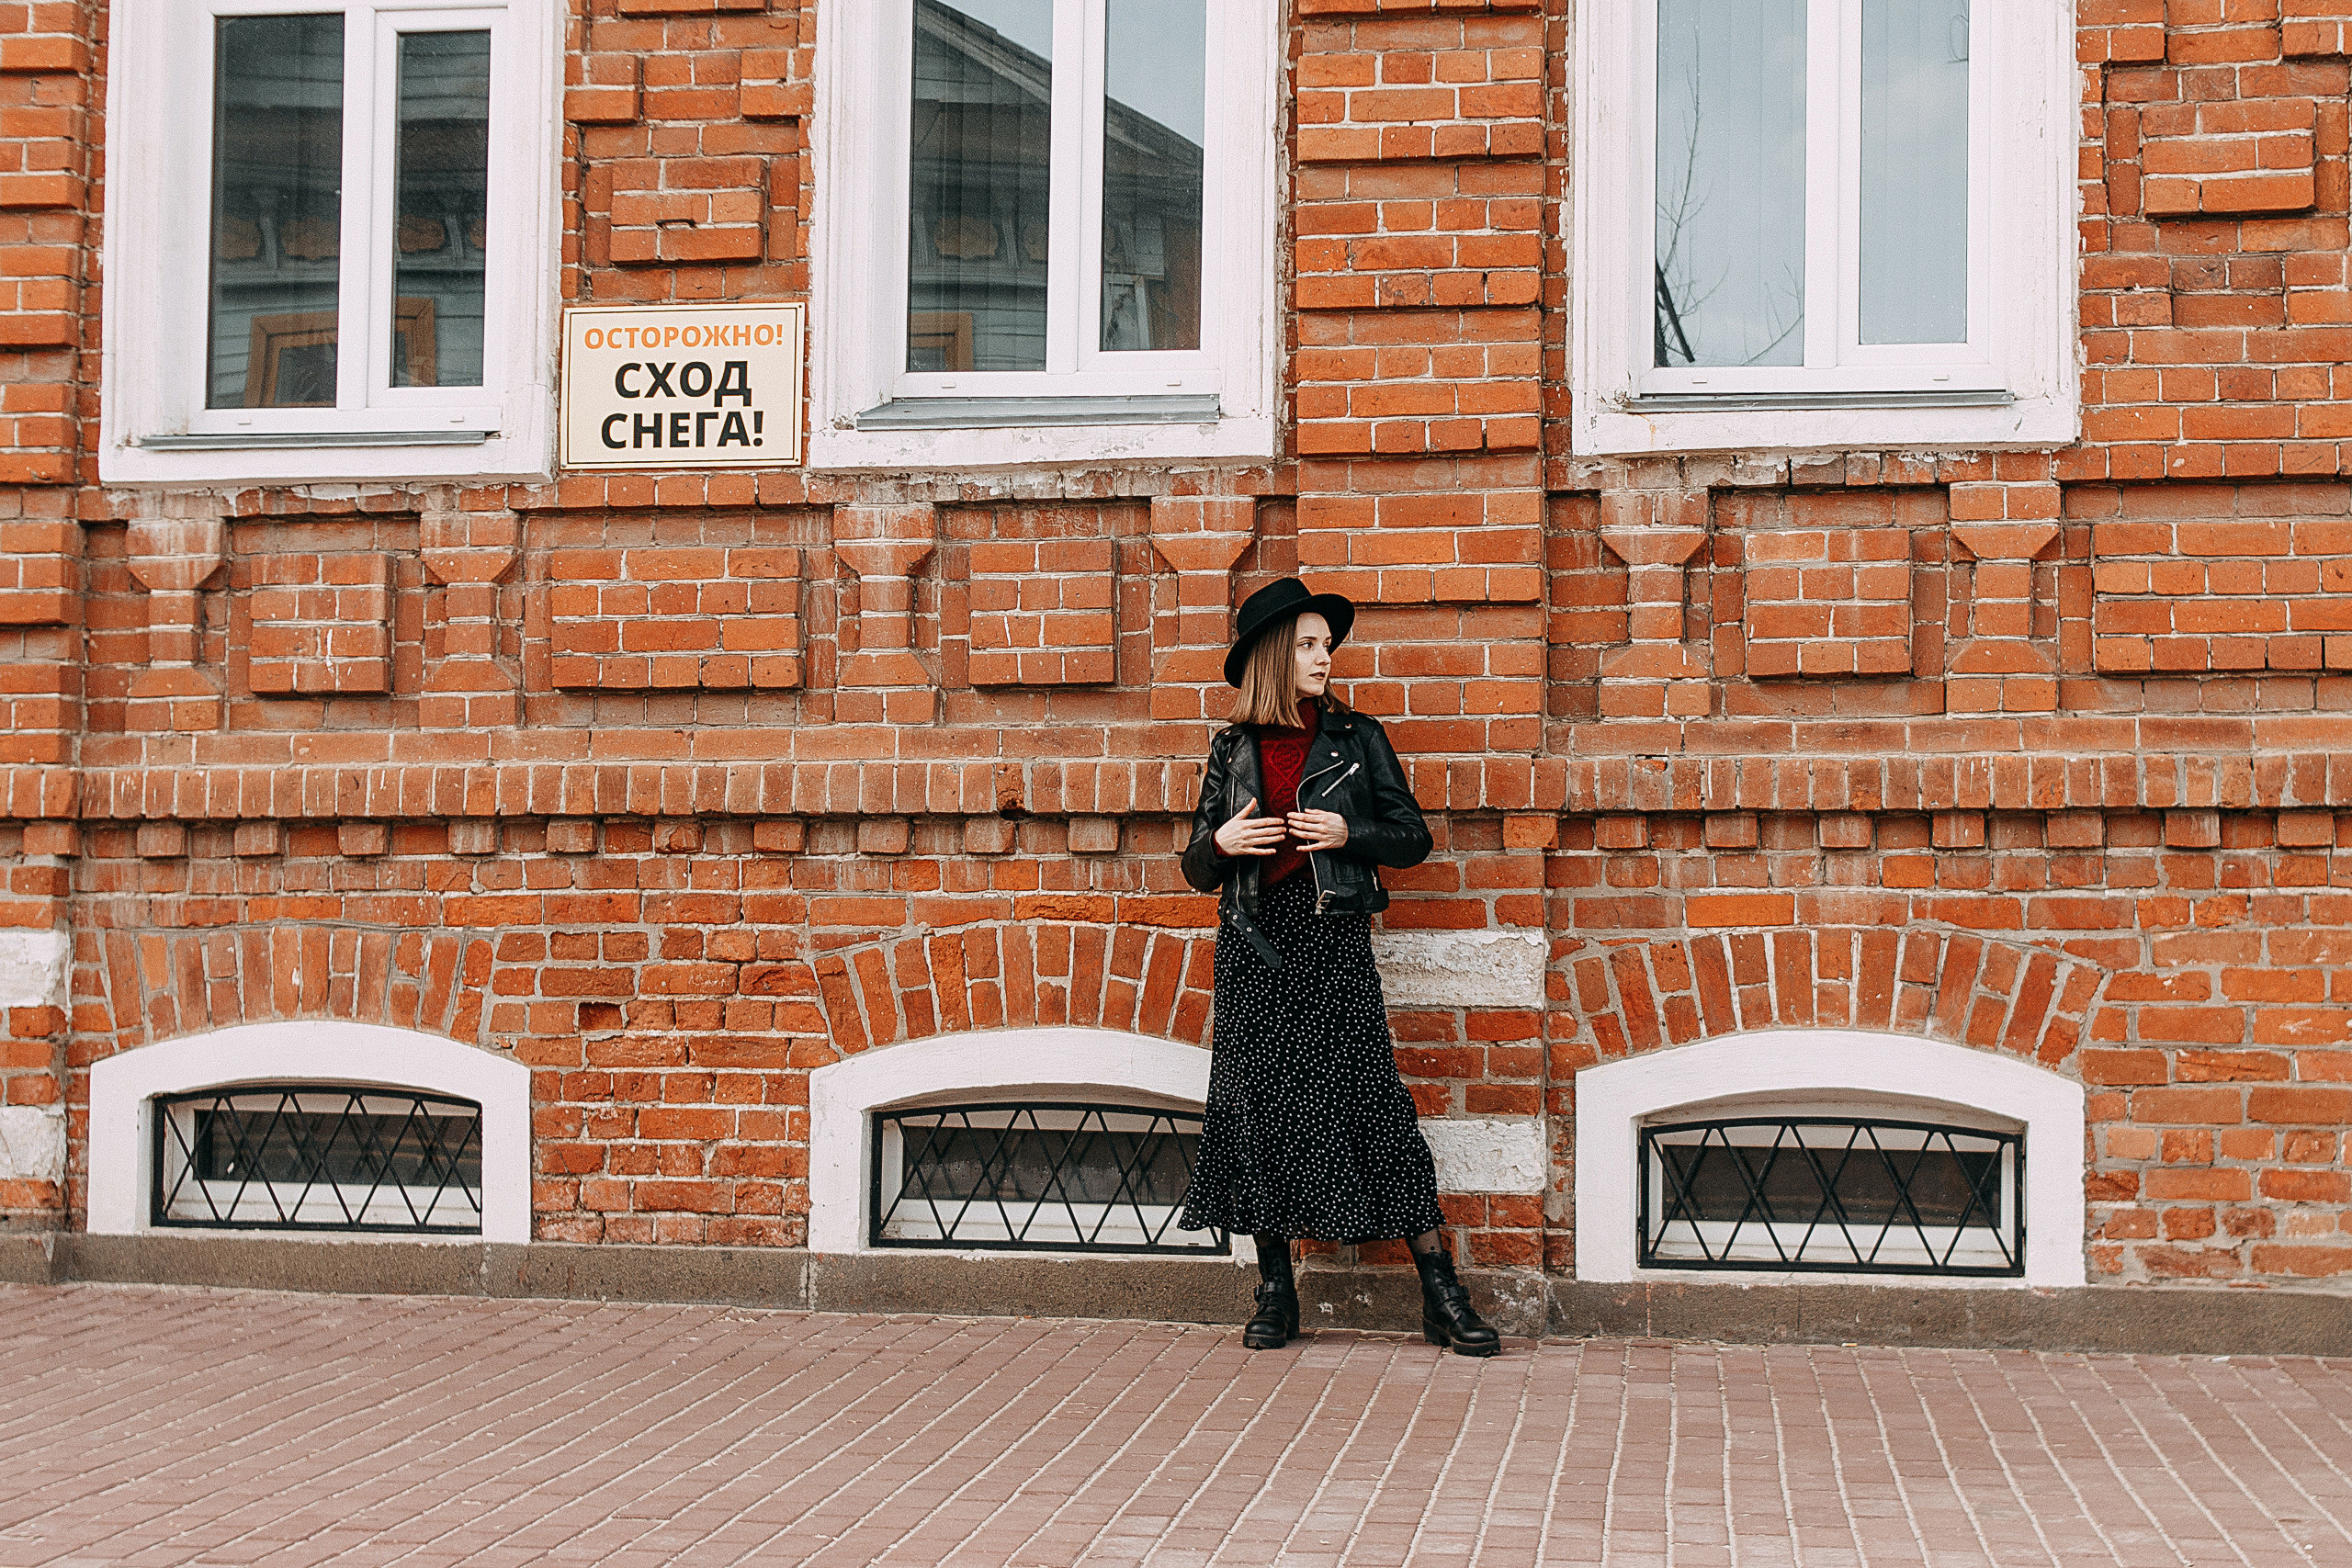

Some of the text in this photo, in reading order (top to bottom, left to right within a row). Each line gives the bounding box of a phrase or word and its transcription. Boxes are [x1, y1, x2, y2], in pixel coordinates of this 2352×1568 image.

[584, 324, 783, 349] ОСТОРОЖНО!
[615, 361, 752, 408] СХОД
[601, 411, 764, 449] СНЕГА!
